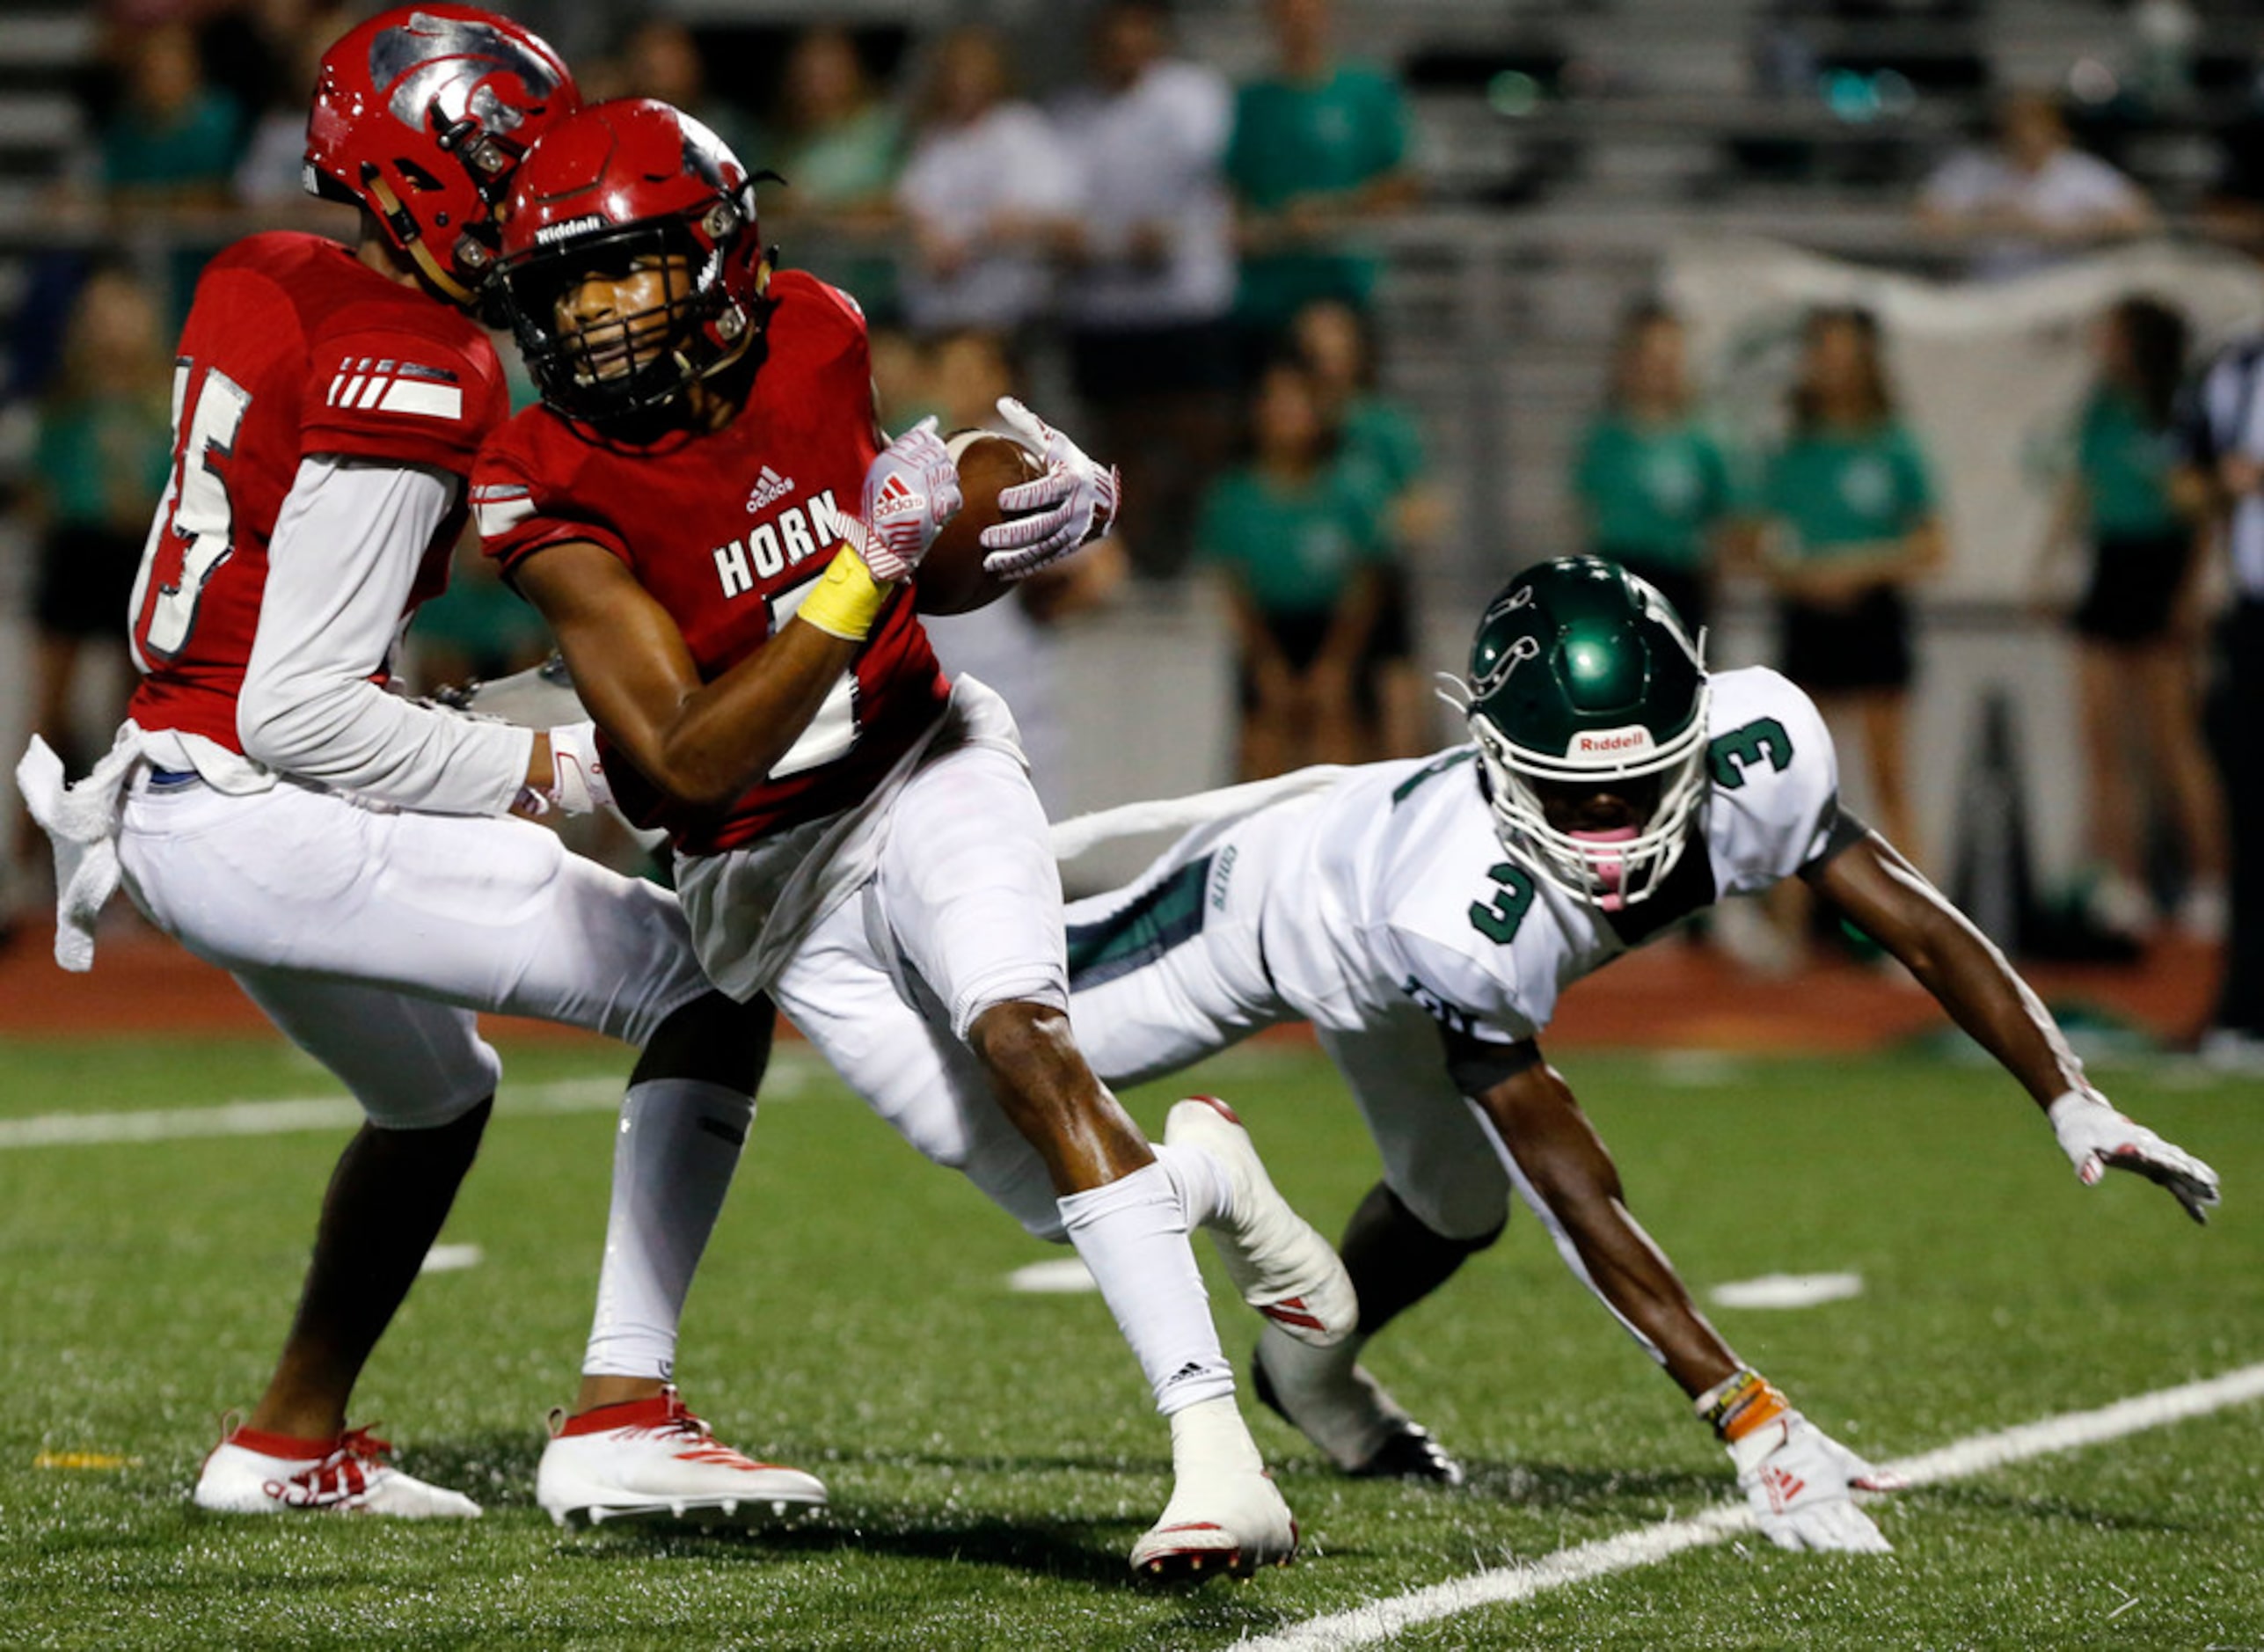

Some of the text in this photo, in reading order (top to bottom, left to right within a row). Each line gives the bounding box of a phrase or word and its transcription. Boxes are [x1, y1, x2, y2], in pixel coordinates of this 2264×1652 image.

[534, 216, 600, 245] Riddell
[746, 476, 795, 514] adidas
[712, 489, 842, 600] HORN
[1580, 730, 1643, 751] Riddell
[1706, 716, 1794, 790] 3
[1212, 844, 1238, 911] COLTS
[1468, 862, 1536, 946] 3
